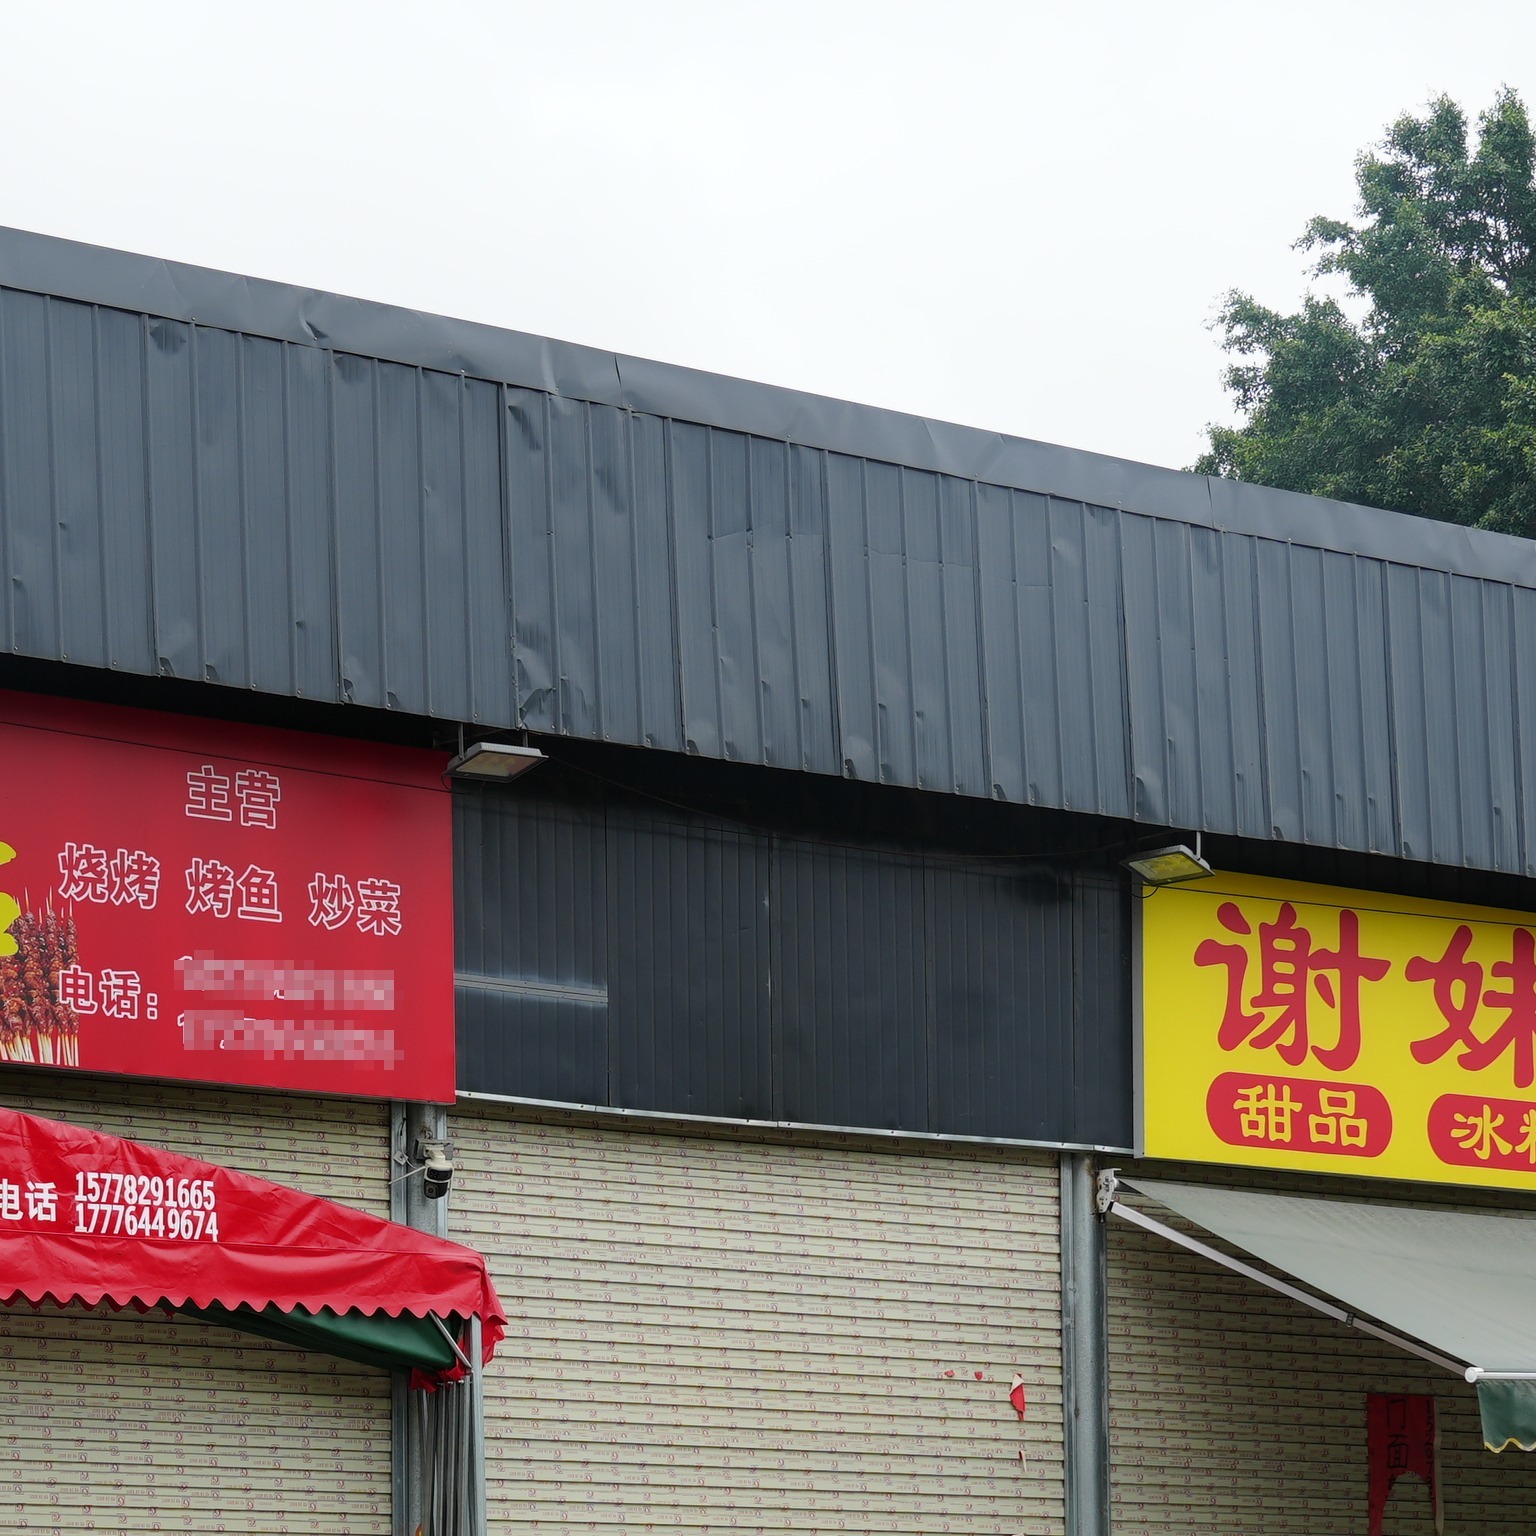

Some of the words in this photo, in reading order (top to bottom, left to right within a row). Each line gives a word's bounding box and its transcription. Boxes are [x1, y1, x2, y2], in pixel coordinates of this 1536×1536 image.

[185, 765, 281, 830] 主营
[58, 842, 160, 909] 烧烤
[185, 858, 283, 923] 烤鱼
[308, 873, 403, 936] 炒菜
[1232, 1087, 1369, 1150] 甜品
[74, 1171, 216, 1211] 15778291665
[74, 1202, 219, 1243] 17776449674
